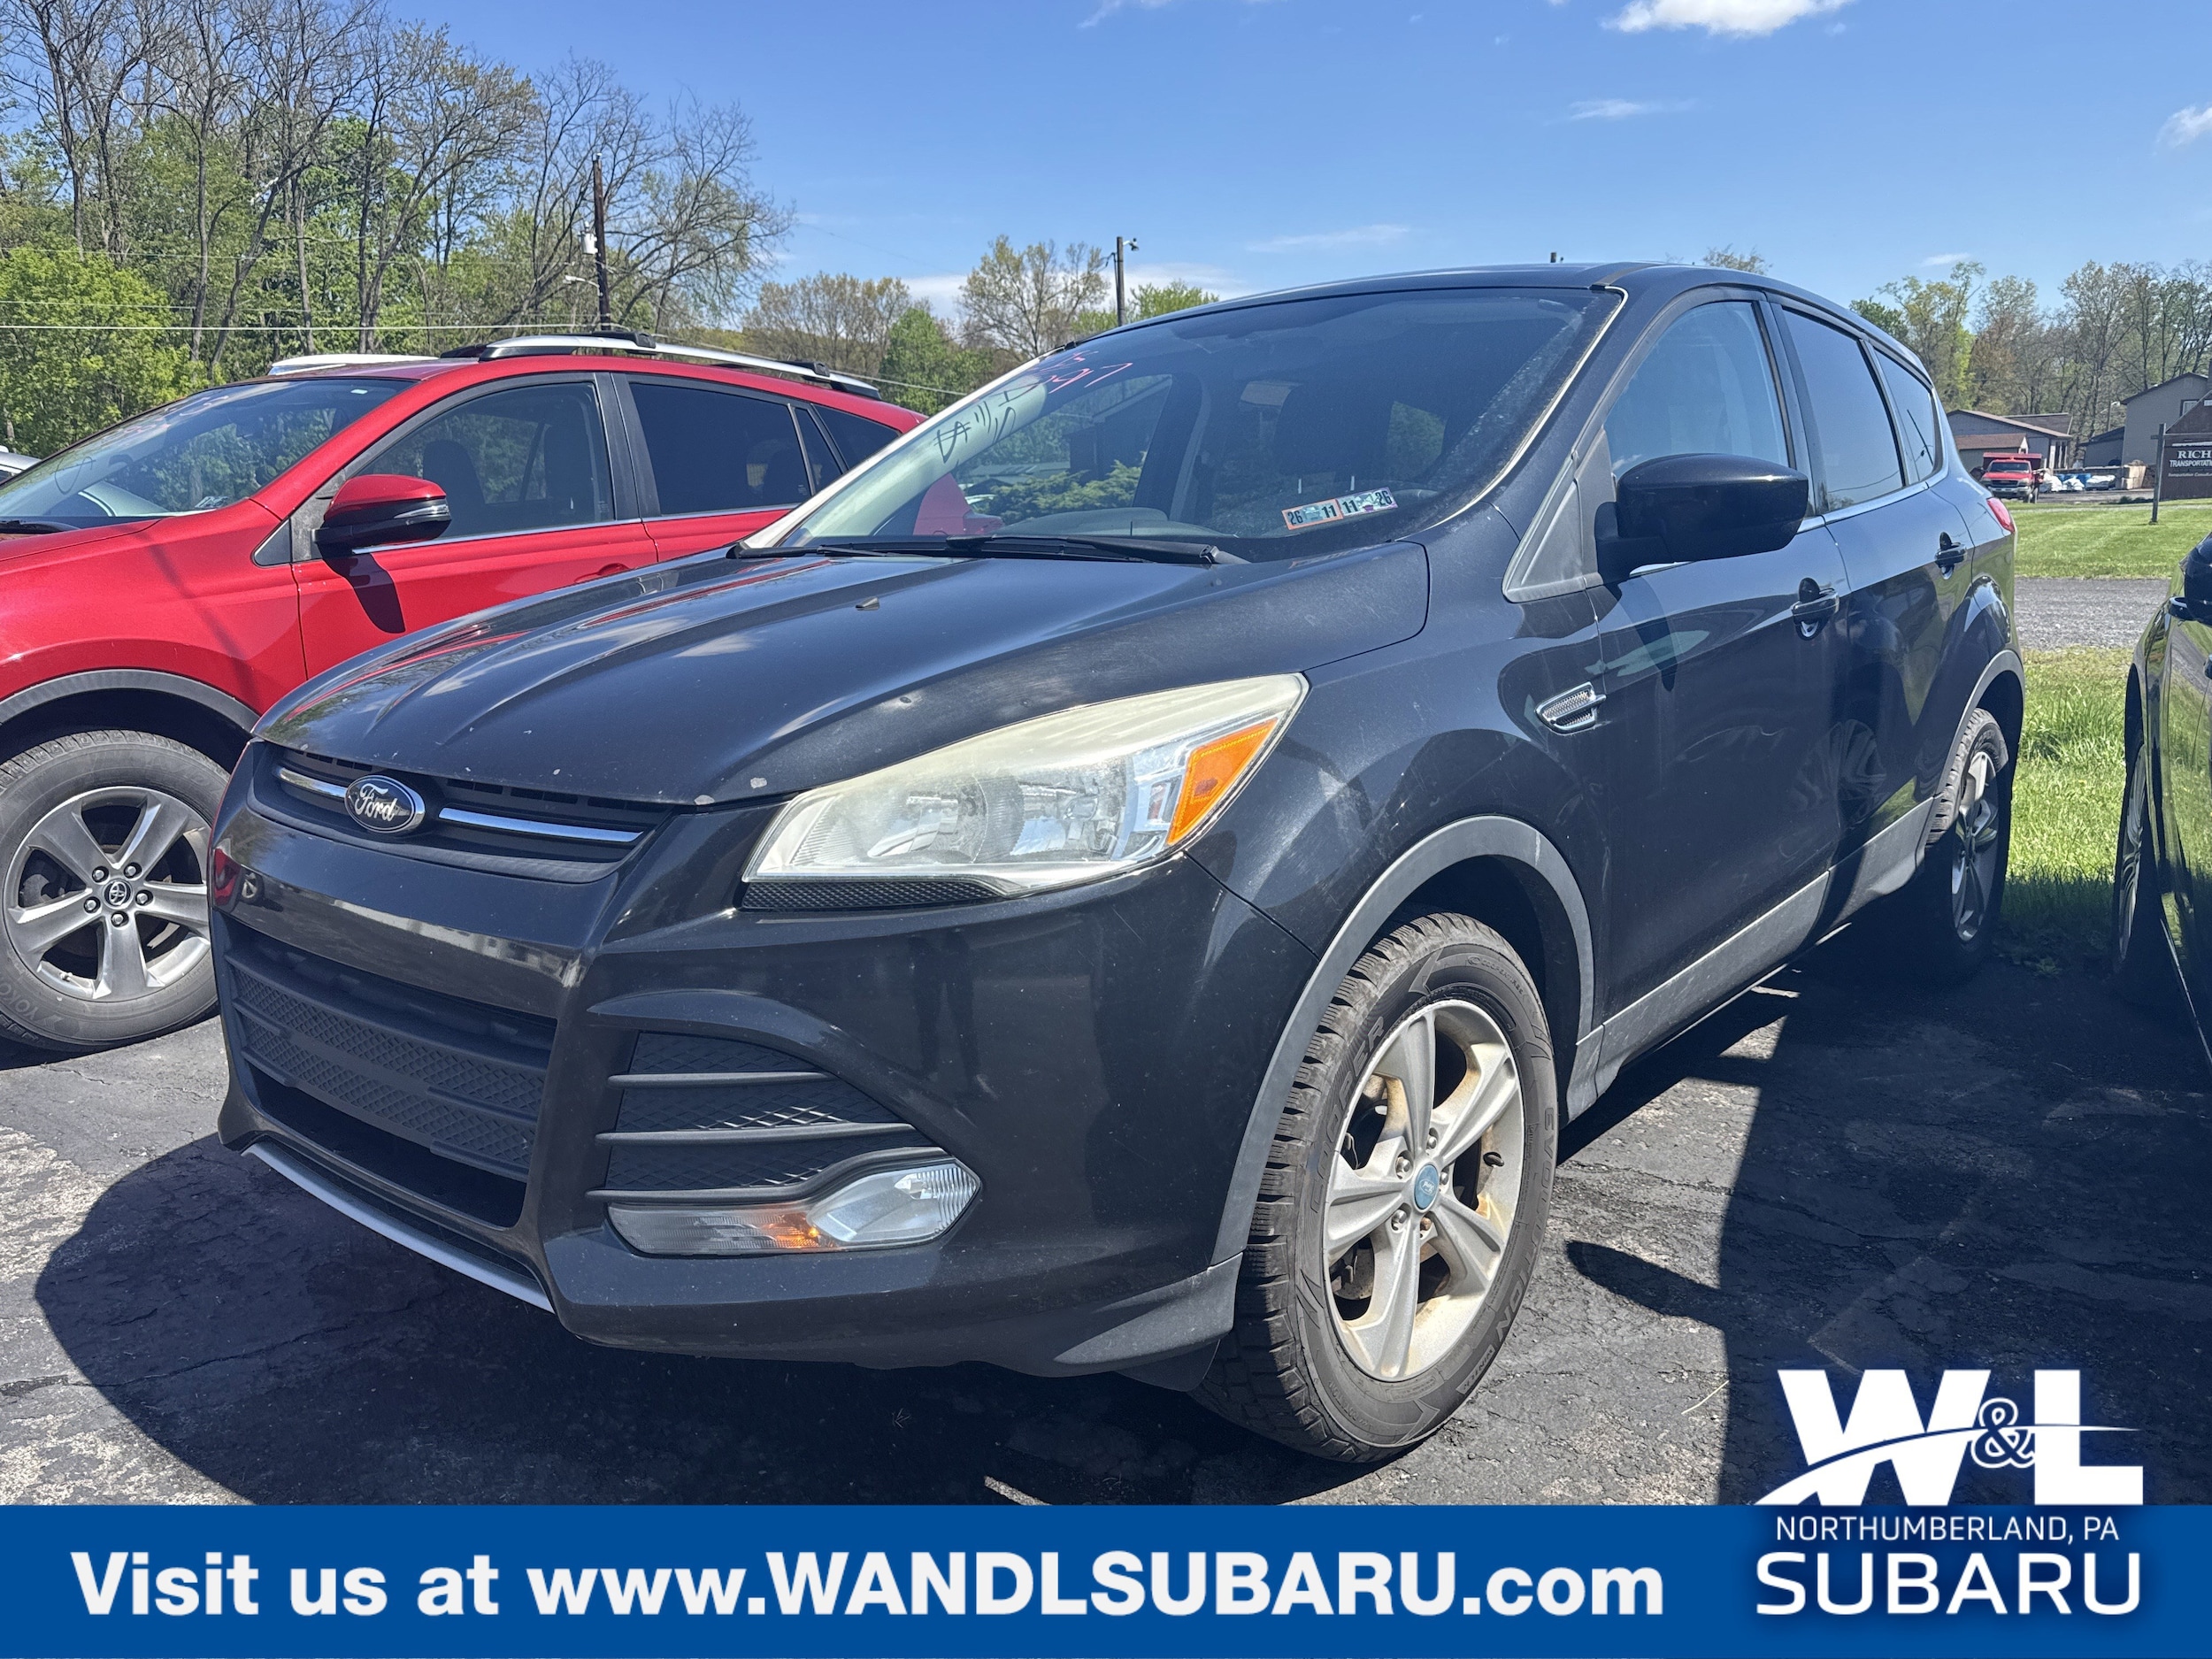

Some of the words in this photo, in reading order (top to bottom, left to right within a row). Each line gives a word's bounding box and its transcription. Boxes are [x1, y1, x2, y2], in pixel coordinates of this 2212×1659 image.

[1287, 510, 1303, 526] 26
[1321, 504, 1337, 518] 11
[1341, 499, 1359, 514] 11
[1374, 489, 1393, 507] 26
[354, 782, 398, 822] Ford
[1310, 1016, 1385, 1214] COOPER
